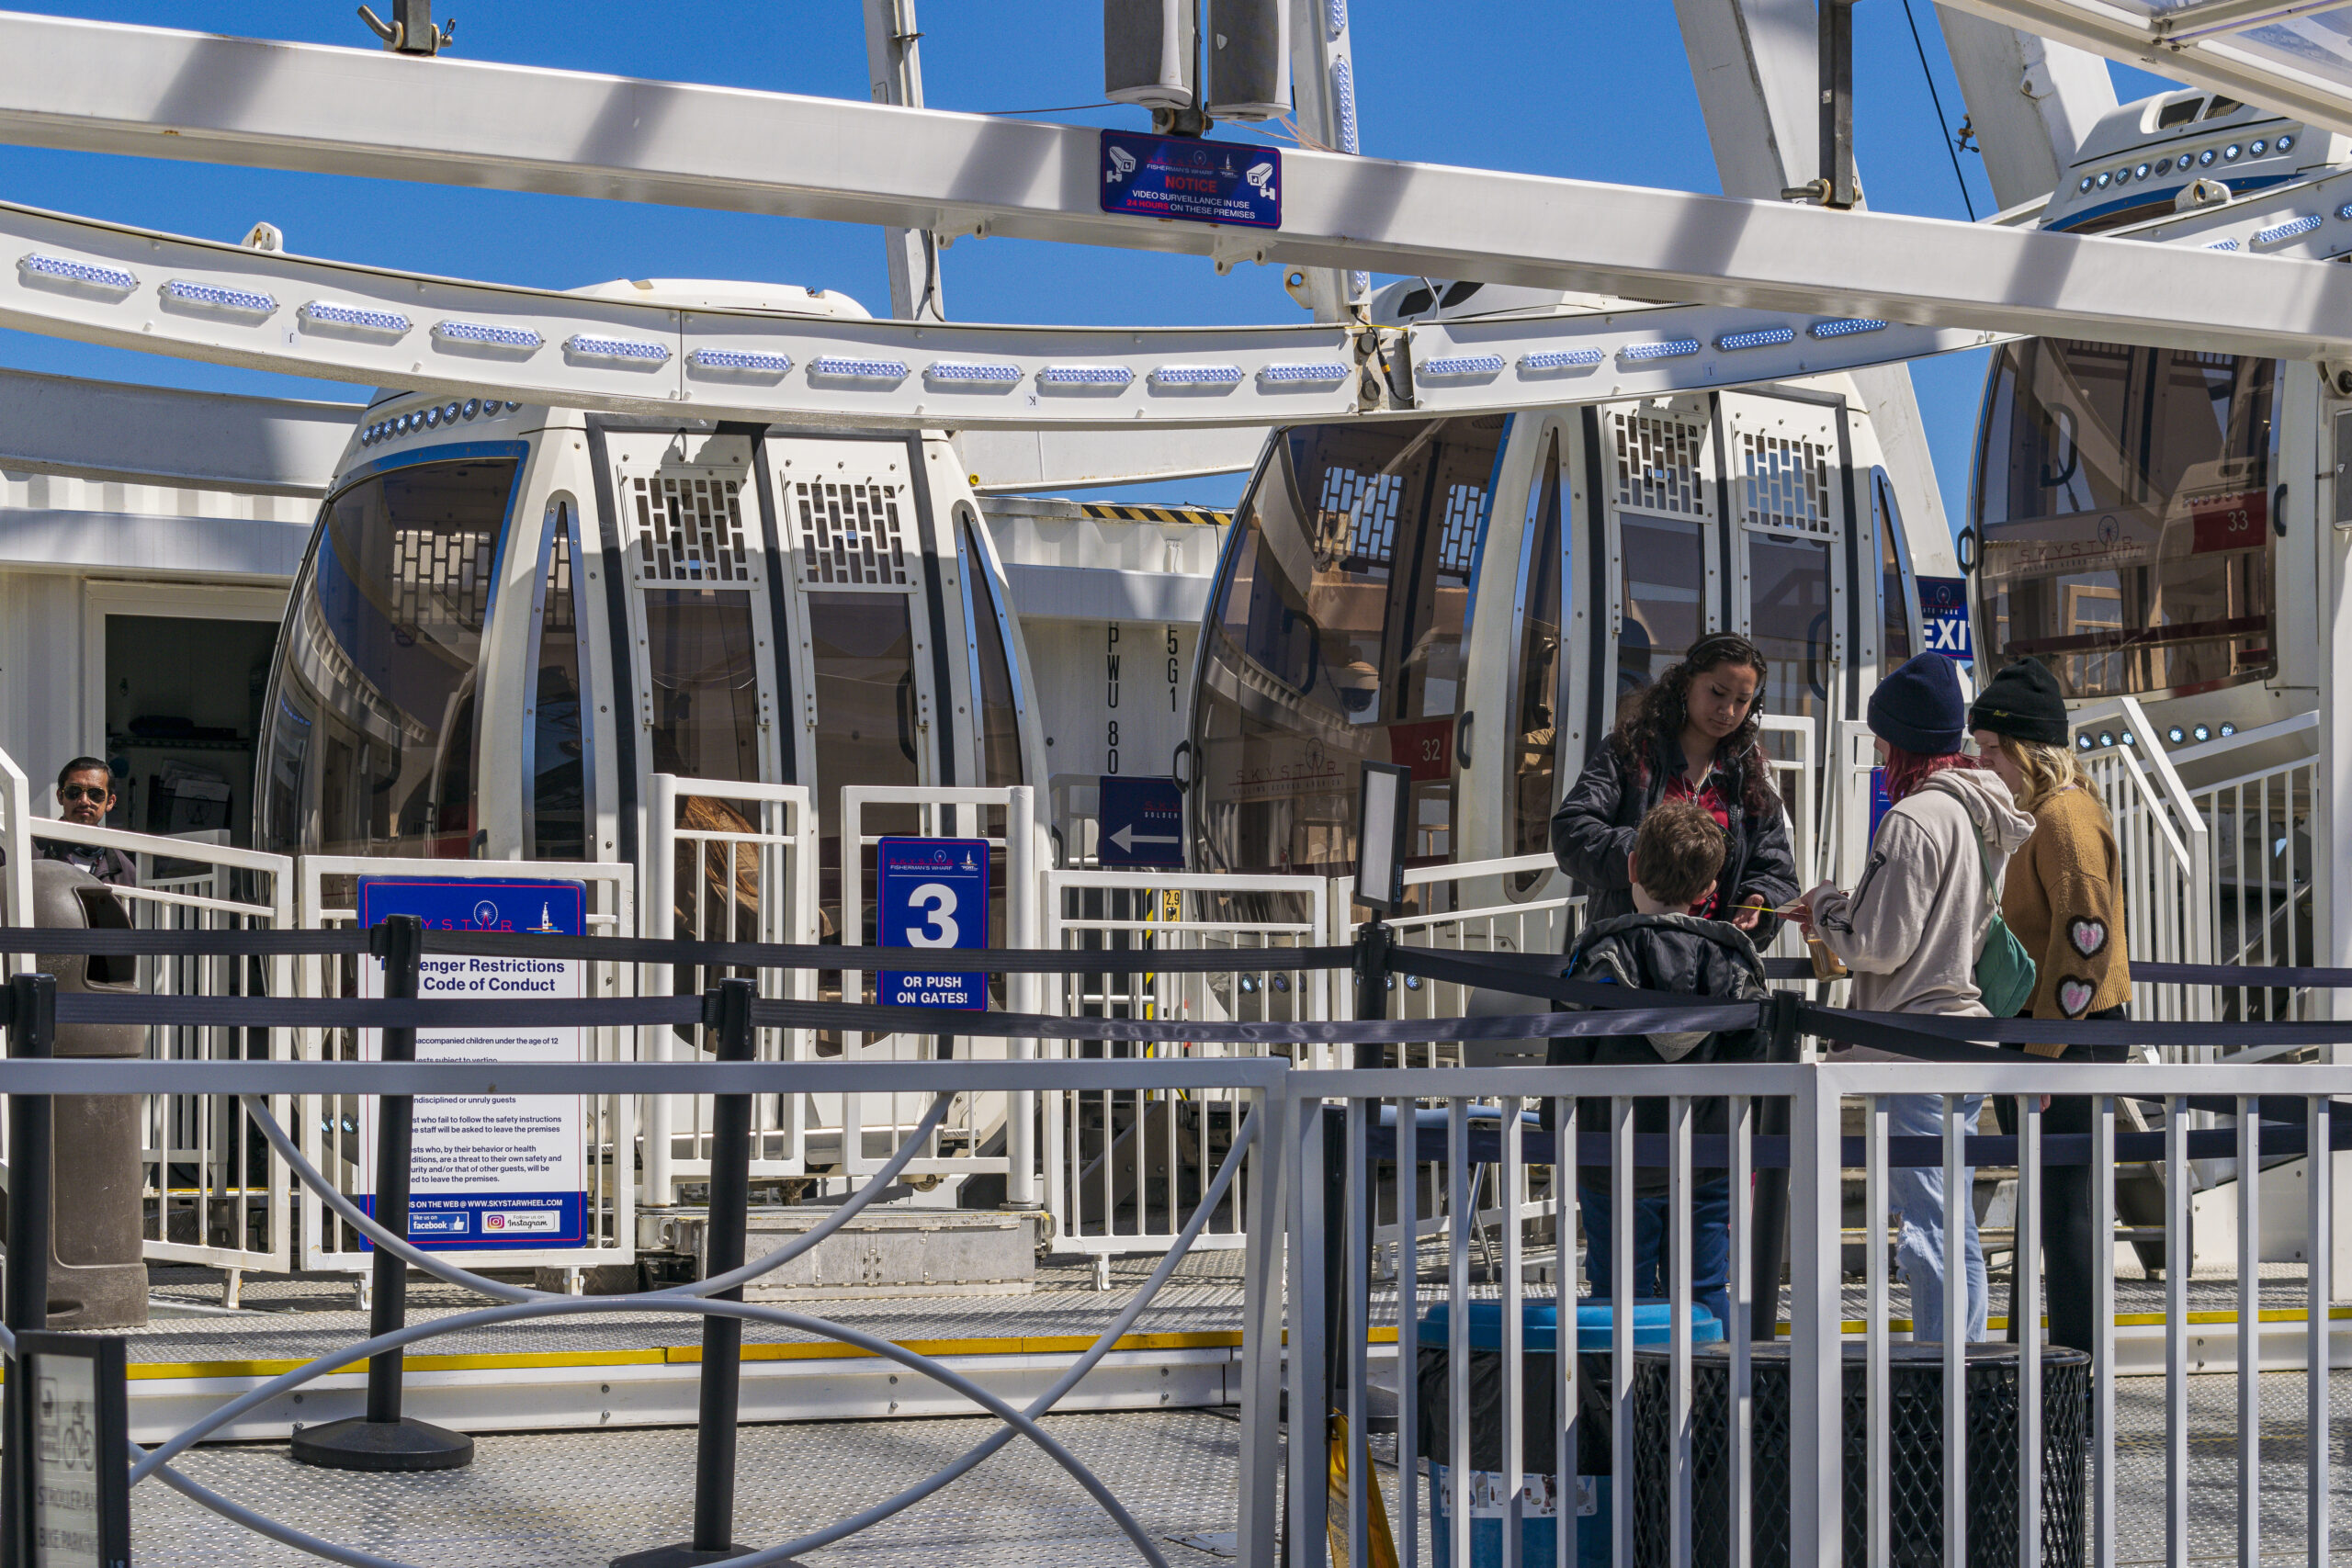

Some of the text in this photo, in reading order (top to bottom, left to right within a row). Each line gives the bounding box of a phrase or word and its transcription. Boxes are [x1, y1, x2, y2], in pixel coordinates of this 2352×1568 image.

[1147, 164, 1190, 174] FISHERMAN'S
[1165, 175, 1217, 193] NOTICE
[1132, 190, 1159, 199] VIDEO
[1159, 193, 1223, 206] SURVEILLANCE
[1233, 200, 1250, 209] USE
[1138, 200, 1169, 210] HOURS
[1170, 203, 1181, 211] ON
[1184, 205, 1212, 215] THESE
[1213, 208, 1256, 220] PREMISES
[2227, 511, 2248, 533] 33
[2020, 536, 2132, 561] SKYSTAR
[1923, 619, 1969, 650] EXI
[1107, 626, 1120, 708] PWU
[1168, 628, 1179, 713] 5G1
[1422, 739, 1442, 761] 32
[1236, 761, 1336, 784] SKYSTAR
[906, 883, 959, 948] 3
[381, 919, 513, 931] YSTAR
[419, 958, 565, 975] enger Restrictions
[424, 976, 555, 991] Code of Conduct
[903, 976, 962, 987] OR PUSH
[897, 992, 968, 1003] ON GATES!
[414, 1037, 559, 1045] accompanied children under the age of 12
[413, 1096, 516, 1105] ndisciplined or unruly guests
[421, 1115, 436, 1124] who
[437, 1115, 449, 1124] fail
[450, 1115, 458, 1124] to
[458, 1115, 481, 1124] follow
[482, 1115, 494, 1124] the
[495, 1115, 518, 1124] safety
[519, 1115, 561, 1124] instructions
[420, 1125, 436, 1134] staff
[437, 1125, 450, 1134] will
[451, 1125, 460, 1134] be
[461, 1125, 483, 1134] asked
[484, 1125, 492, 1134] to
[493, 1125, 514, 1134] leave
[514, 1125, 526, 1134] the
[527, 1125, 560, 1134] premises
[444, 1145, 453, 1155] by
[454, 1145, 471, 1155] their
[472, 1145, 503, 1155] behavior
[504, 1145, 513, 1155] or
[514, 1145, 537, 1155] health
[412, 1155, 561, 1164] ditions, are a threat to their own safety and
[411, 1165, 549, 1174] urity and/or that of other guests, will be
[422, 1175, 429, 1184] to
[430, 1175, 450, 1184] leave
[451, 1175, 463, 1184] the
[464, 1175, 500, 1184] premises.
[416, 1200, 426, 1208] ON
[428, 1200, 442, 1208] THE
[443, 1200, 459, 1208] WEB
[460, 1200, 466, 1208] @
[467, 1200, 563, 1208] WWW.SKYSTARWHEEL.COM
[413, 1222, 447, 1230] facebook
[507, 1219, 548, 1229] Instagram
